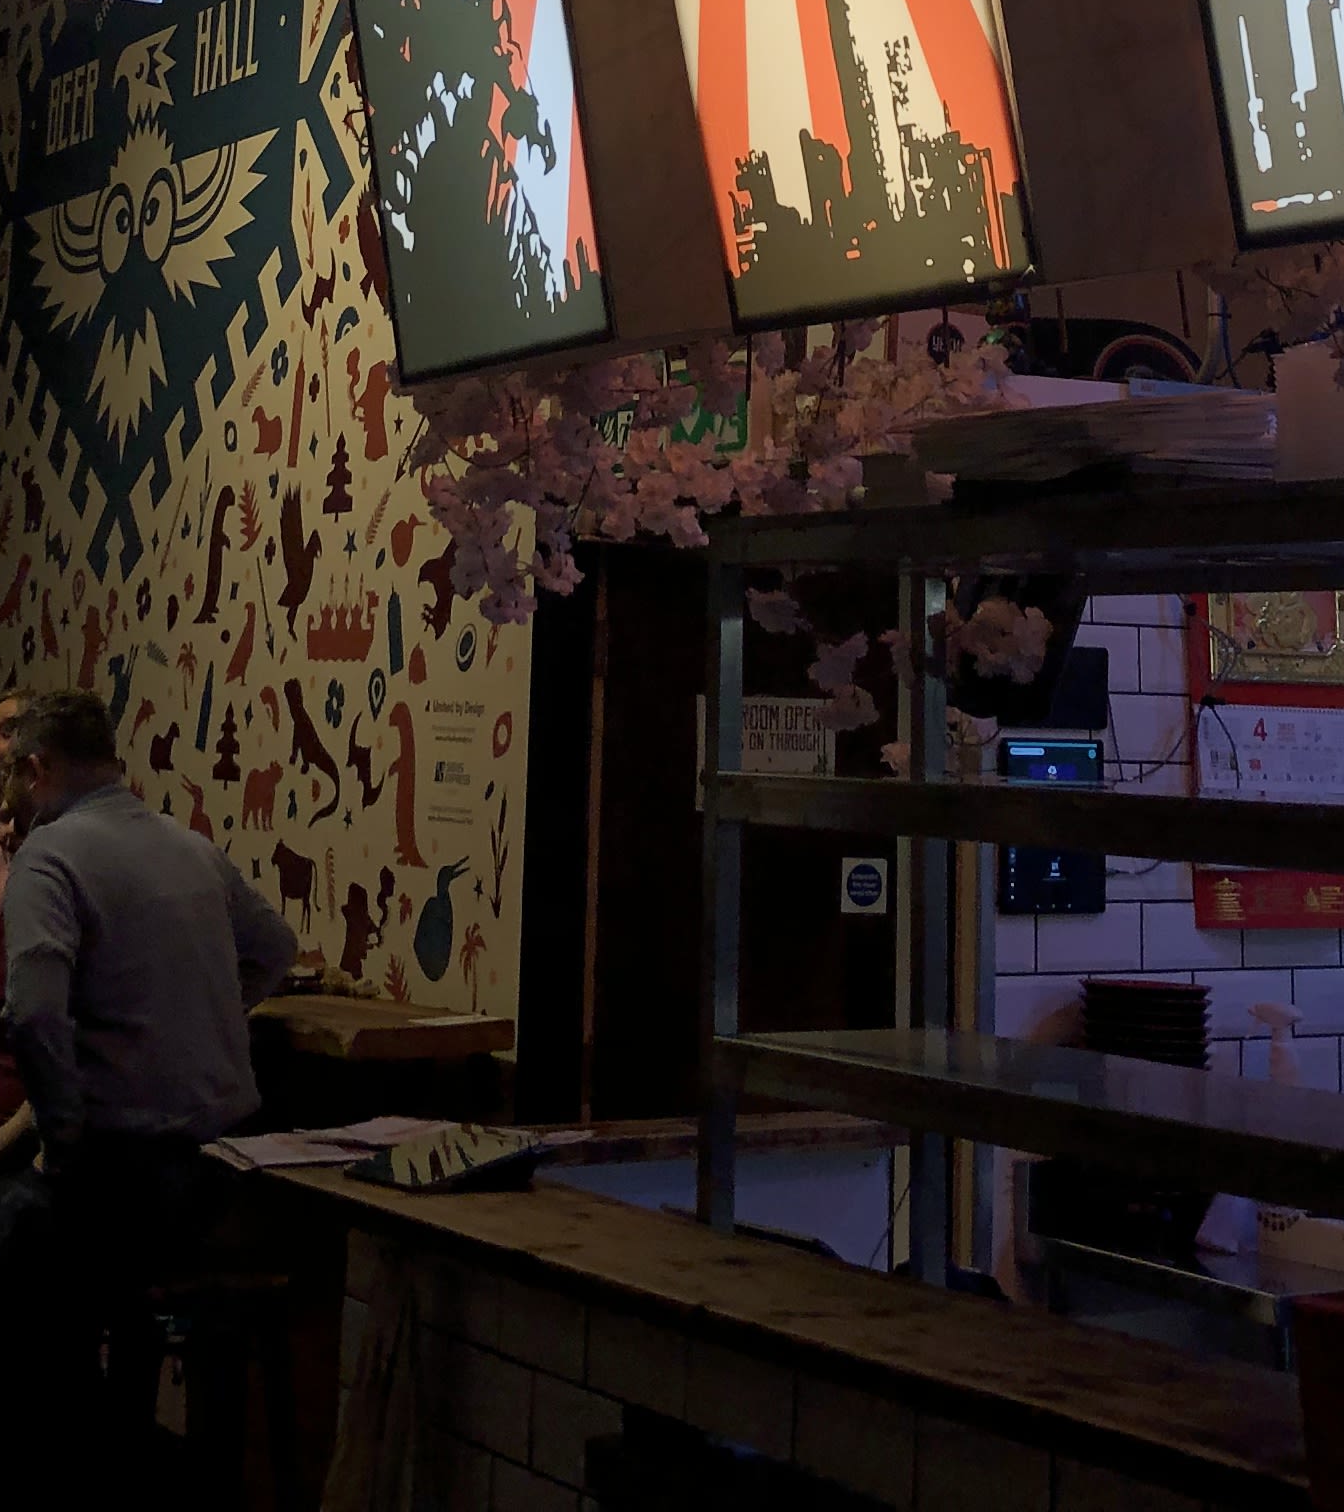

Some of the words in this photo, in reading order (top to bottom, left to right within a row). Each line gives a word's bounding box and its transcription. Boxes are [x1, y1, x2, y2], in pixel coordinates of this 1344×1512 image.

[45, 58, 102, 157] BEER
[1253, 717, 1268, 741] 4
[749, 732, 764, 750] ON
[769, 732, 820, 752] THROUGH
